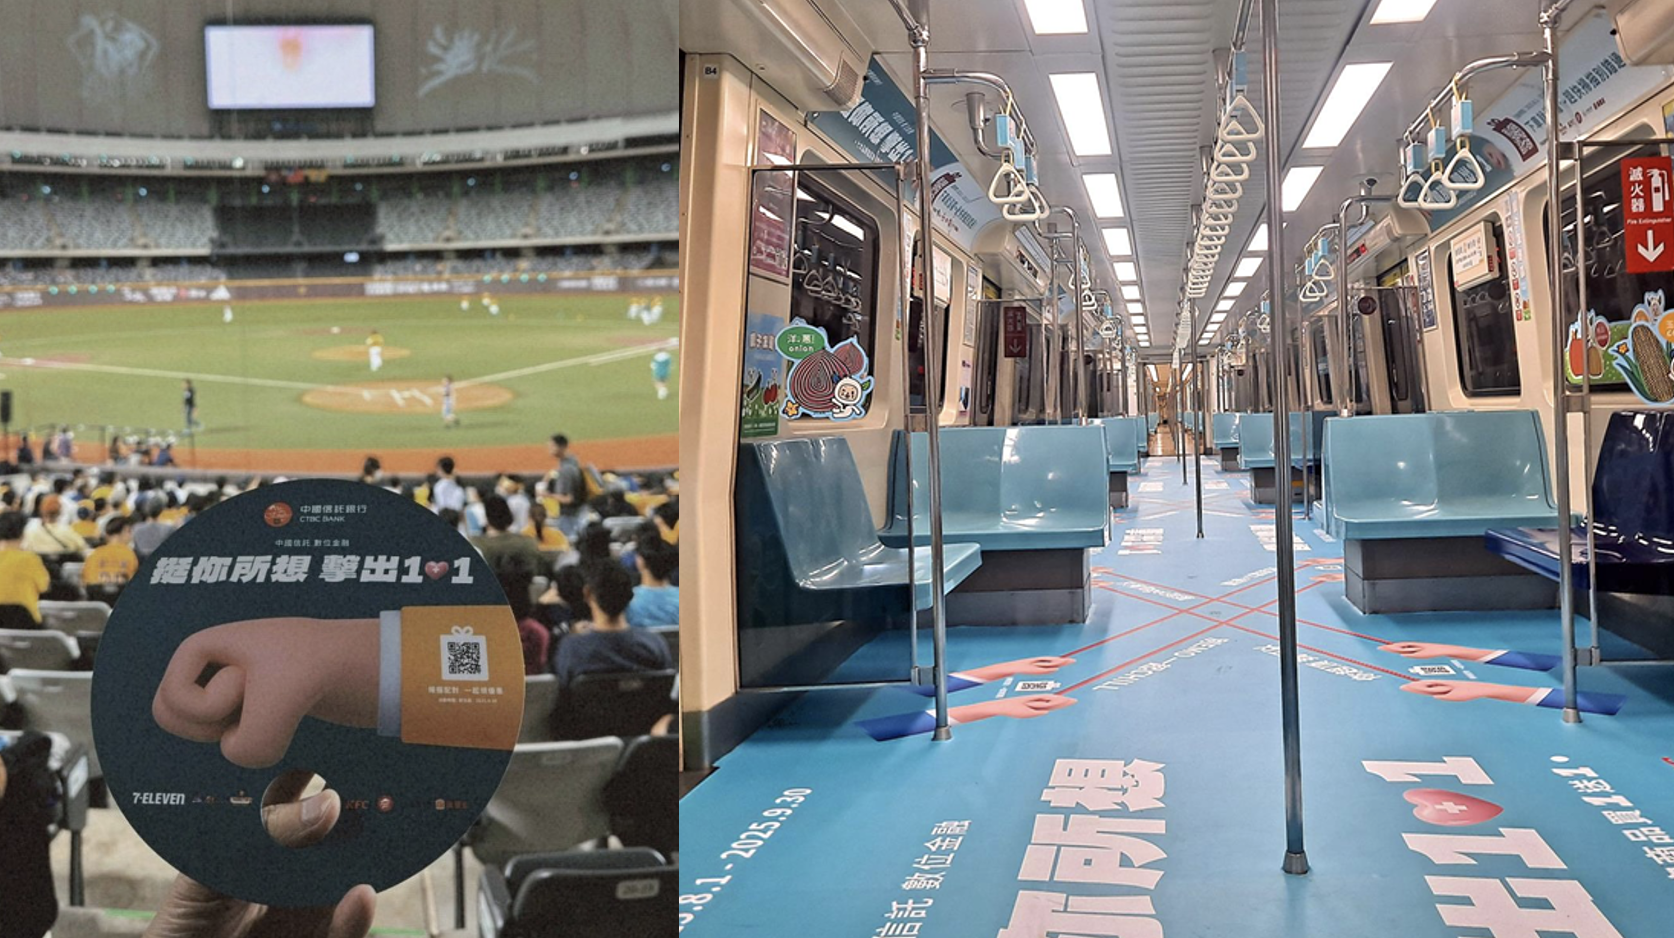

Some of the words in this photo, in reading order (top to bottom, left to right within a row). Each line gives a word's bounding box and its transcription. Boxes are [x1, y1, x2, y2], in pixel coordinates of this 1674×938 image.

[704, 66, 717, 75] B4
[1629, 166, 1645, 212] 滅火器
[300, 505, 367, 514] 中國信託銀行
[149, 555, 310, 585] 挺你所想
[720, 787, 813, 859] 2025.9.30
[901, 819, 972, 891] 數位金融
